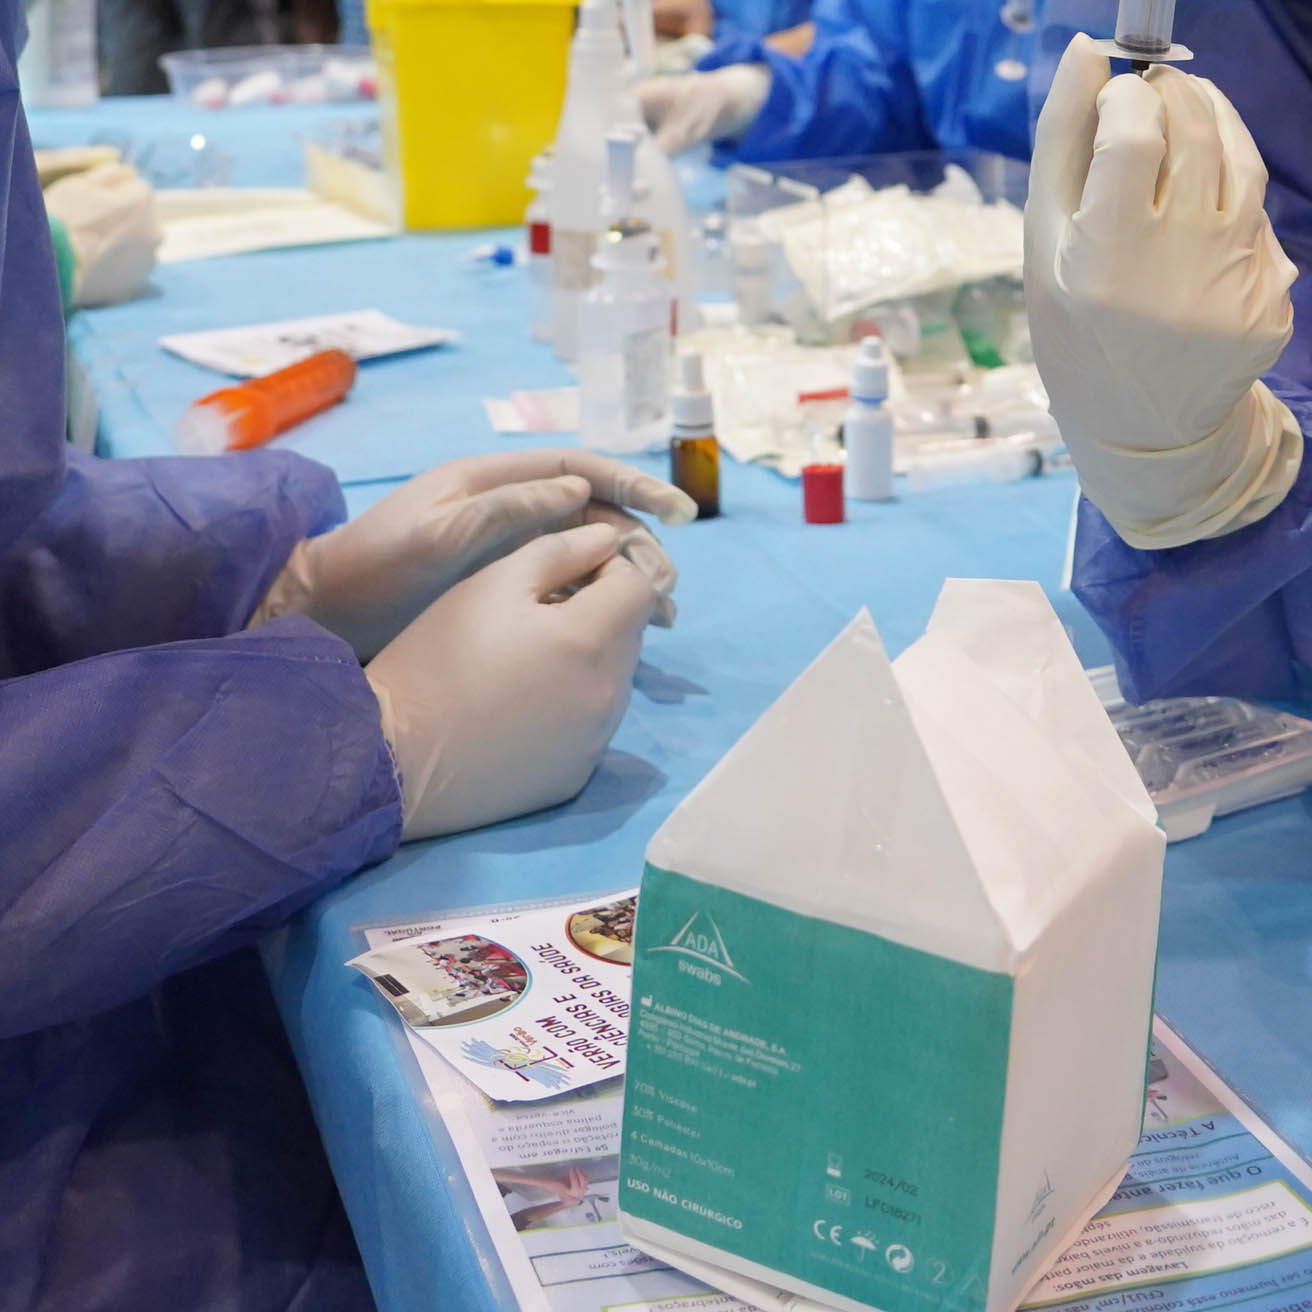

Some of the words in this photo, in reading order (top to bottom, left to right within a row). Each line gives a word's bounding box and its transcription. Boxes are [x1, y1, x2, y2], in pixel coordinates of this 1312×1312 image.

[684, 931, 720, 959] ADA
[530, 942, 581, 976] SAÚDE
[552, 993, 576, 1005] E
[535, 1015, 577, 1039] COM
[567, 1032, 622, 1071] VERÃO
[1201, 1120, 1216, 1131] A
[498, 1145, 514, 1153] do
[1205, 1168, 1242, 1187] que
[1246, 1165, 1262, 1177] O
[626, 1177, 650, 1193] USO
[652, 1187, 678, 1205] NÃO
[1159, 1179, 1205, 1194] fazer
[1245, 1200, 1276, 1214] risco
[1263, 1210, 1287, 1222] das
[1072, 1228, 1137, 1247] utilizando
[1227, 1225, 1285, 1248] remoção
[1150, 1242, 1206, 1260] sujidade
[1208, 1240, 1225, 1252] da
[1075, 1260, 1115, 1274] maior
[1118, 1255, 1135, 1265] da
[1126, 1260, 1189, 1277] Lavagem
[1053, 1276, 1095, 1292] mãos:
[1099, 1271, 1123, 1283] das
[1218, 1279, 1279, 1298] humano
